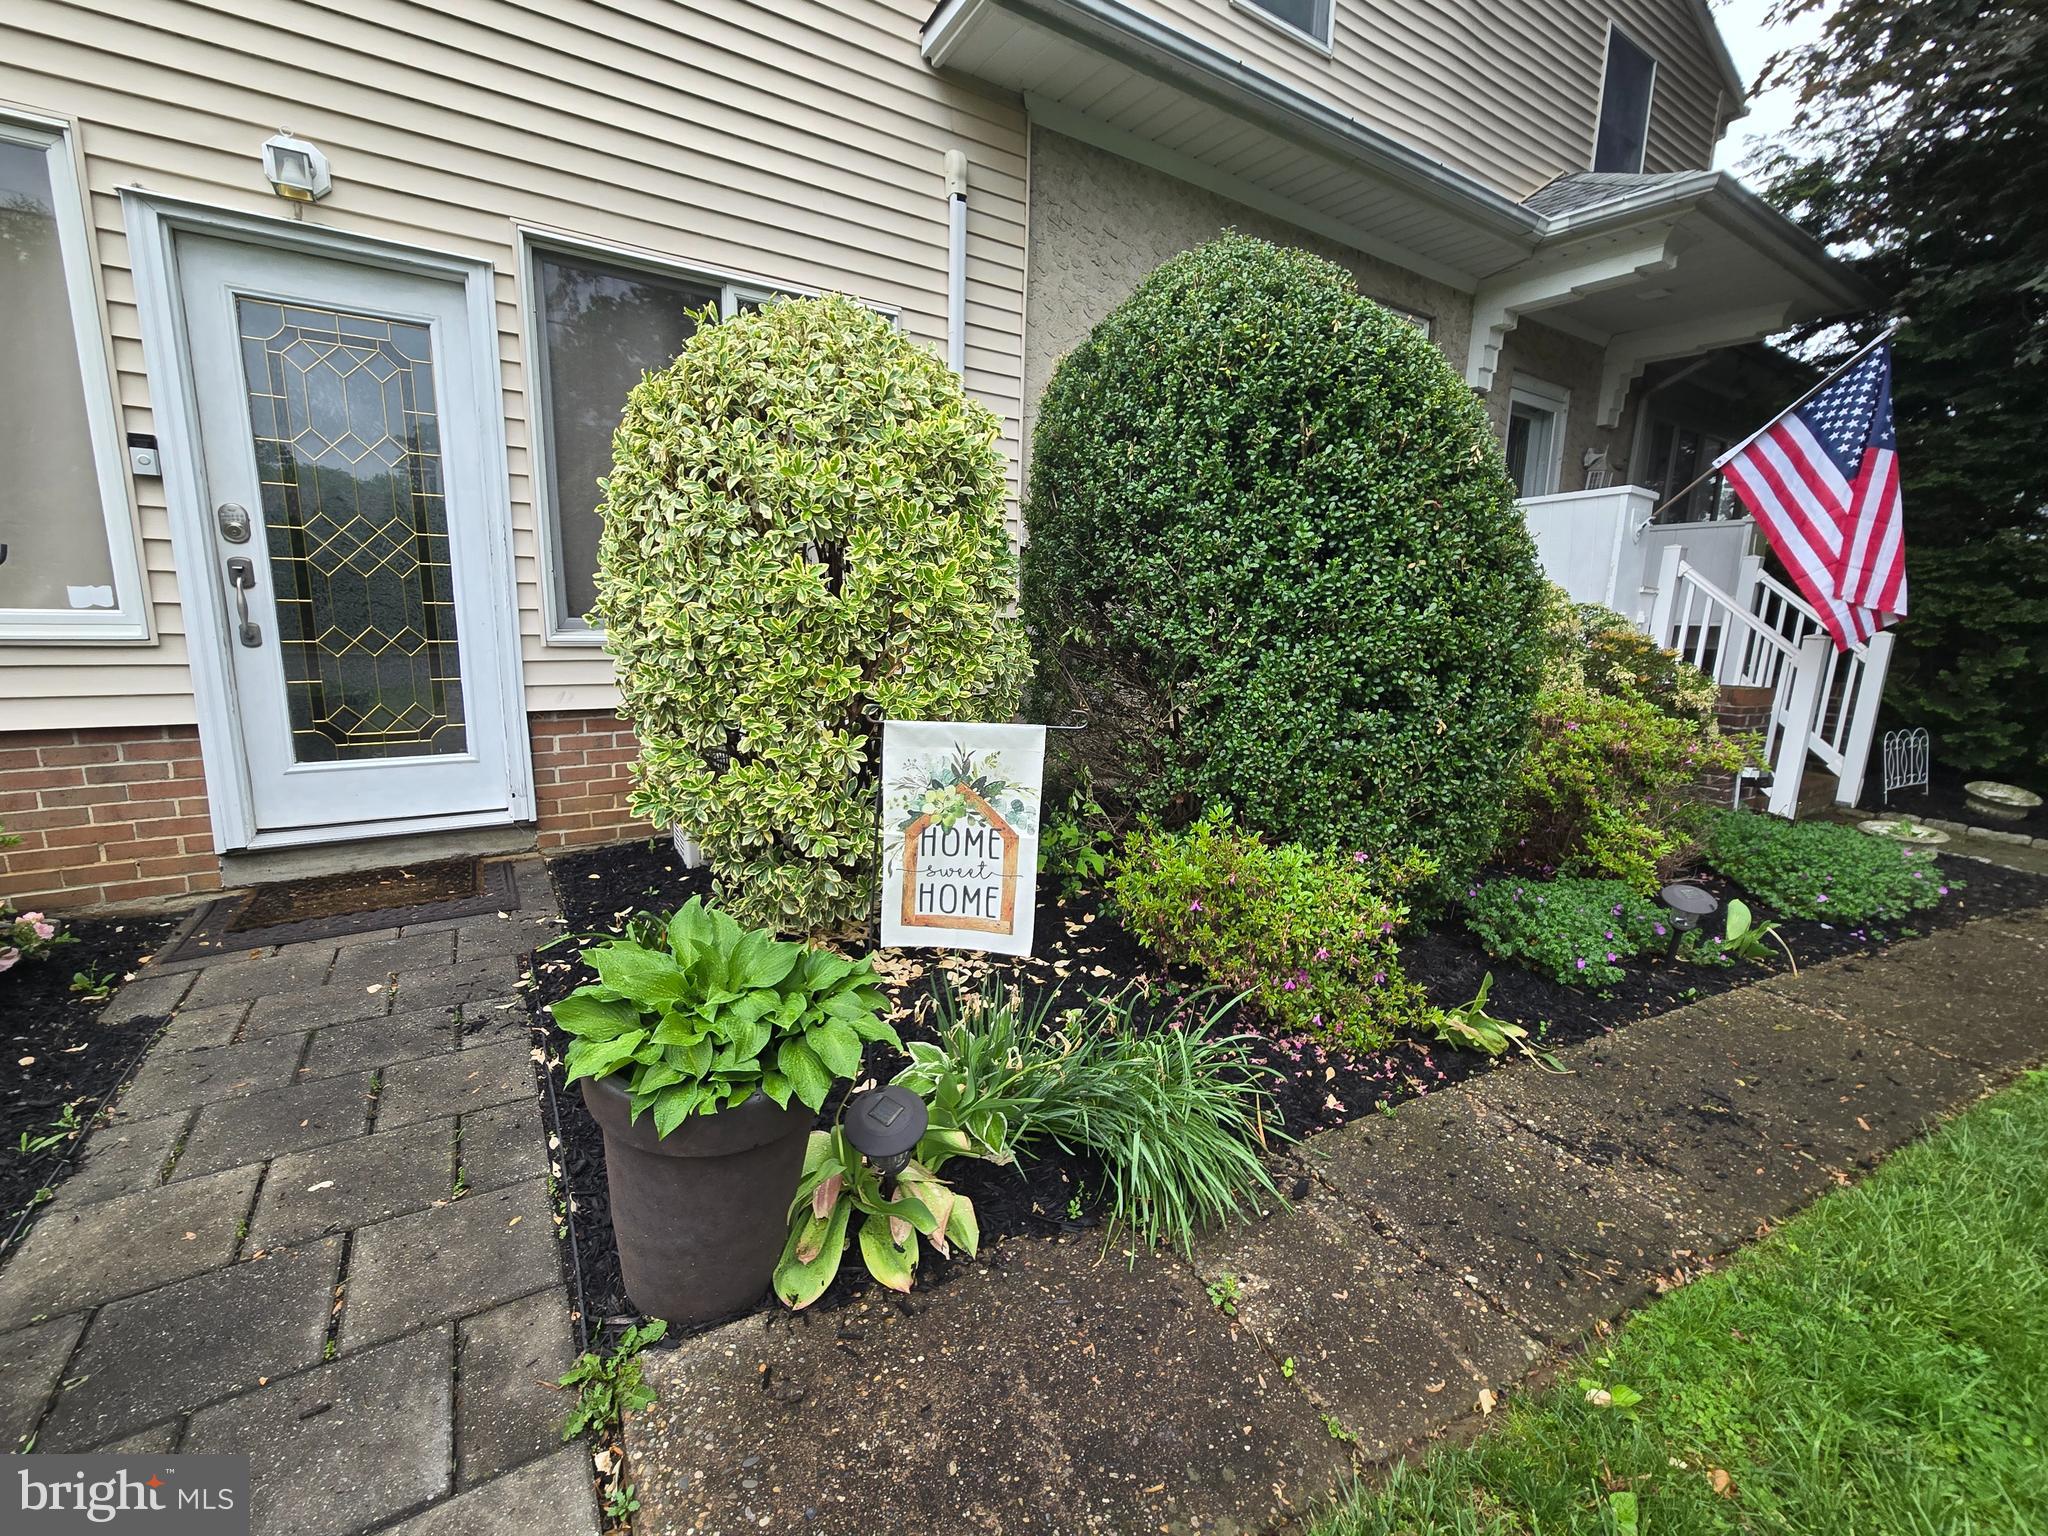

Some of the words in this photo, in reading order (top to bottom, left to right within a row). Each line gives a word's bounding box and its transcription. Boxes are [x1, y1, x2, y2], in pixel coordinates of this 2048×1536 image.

[921, 827, 1001, 860] HOME
[924, 860, 994, 880] sweet
[919, 883, 999, 918] HOME
